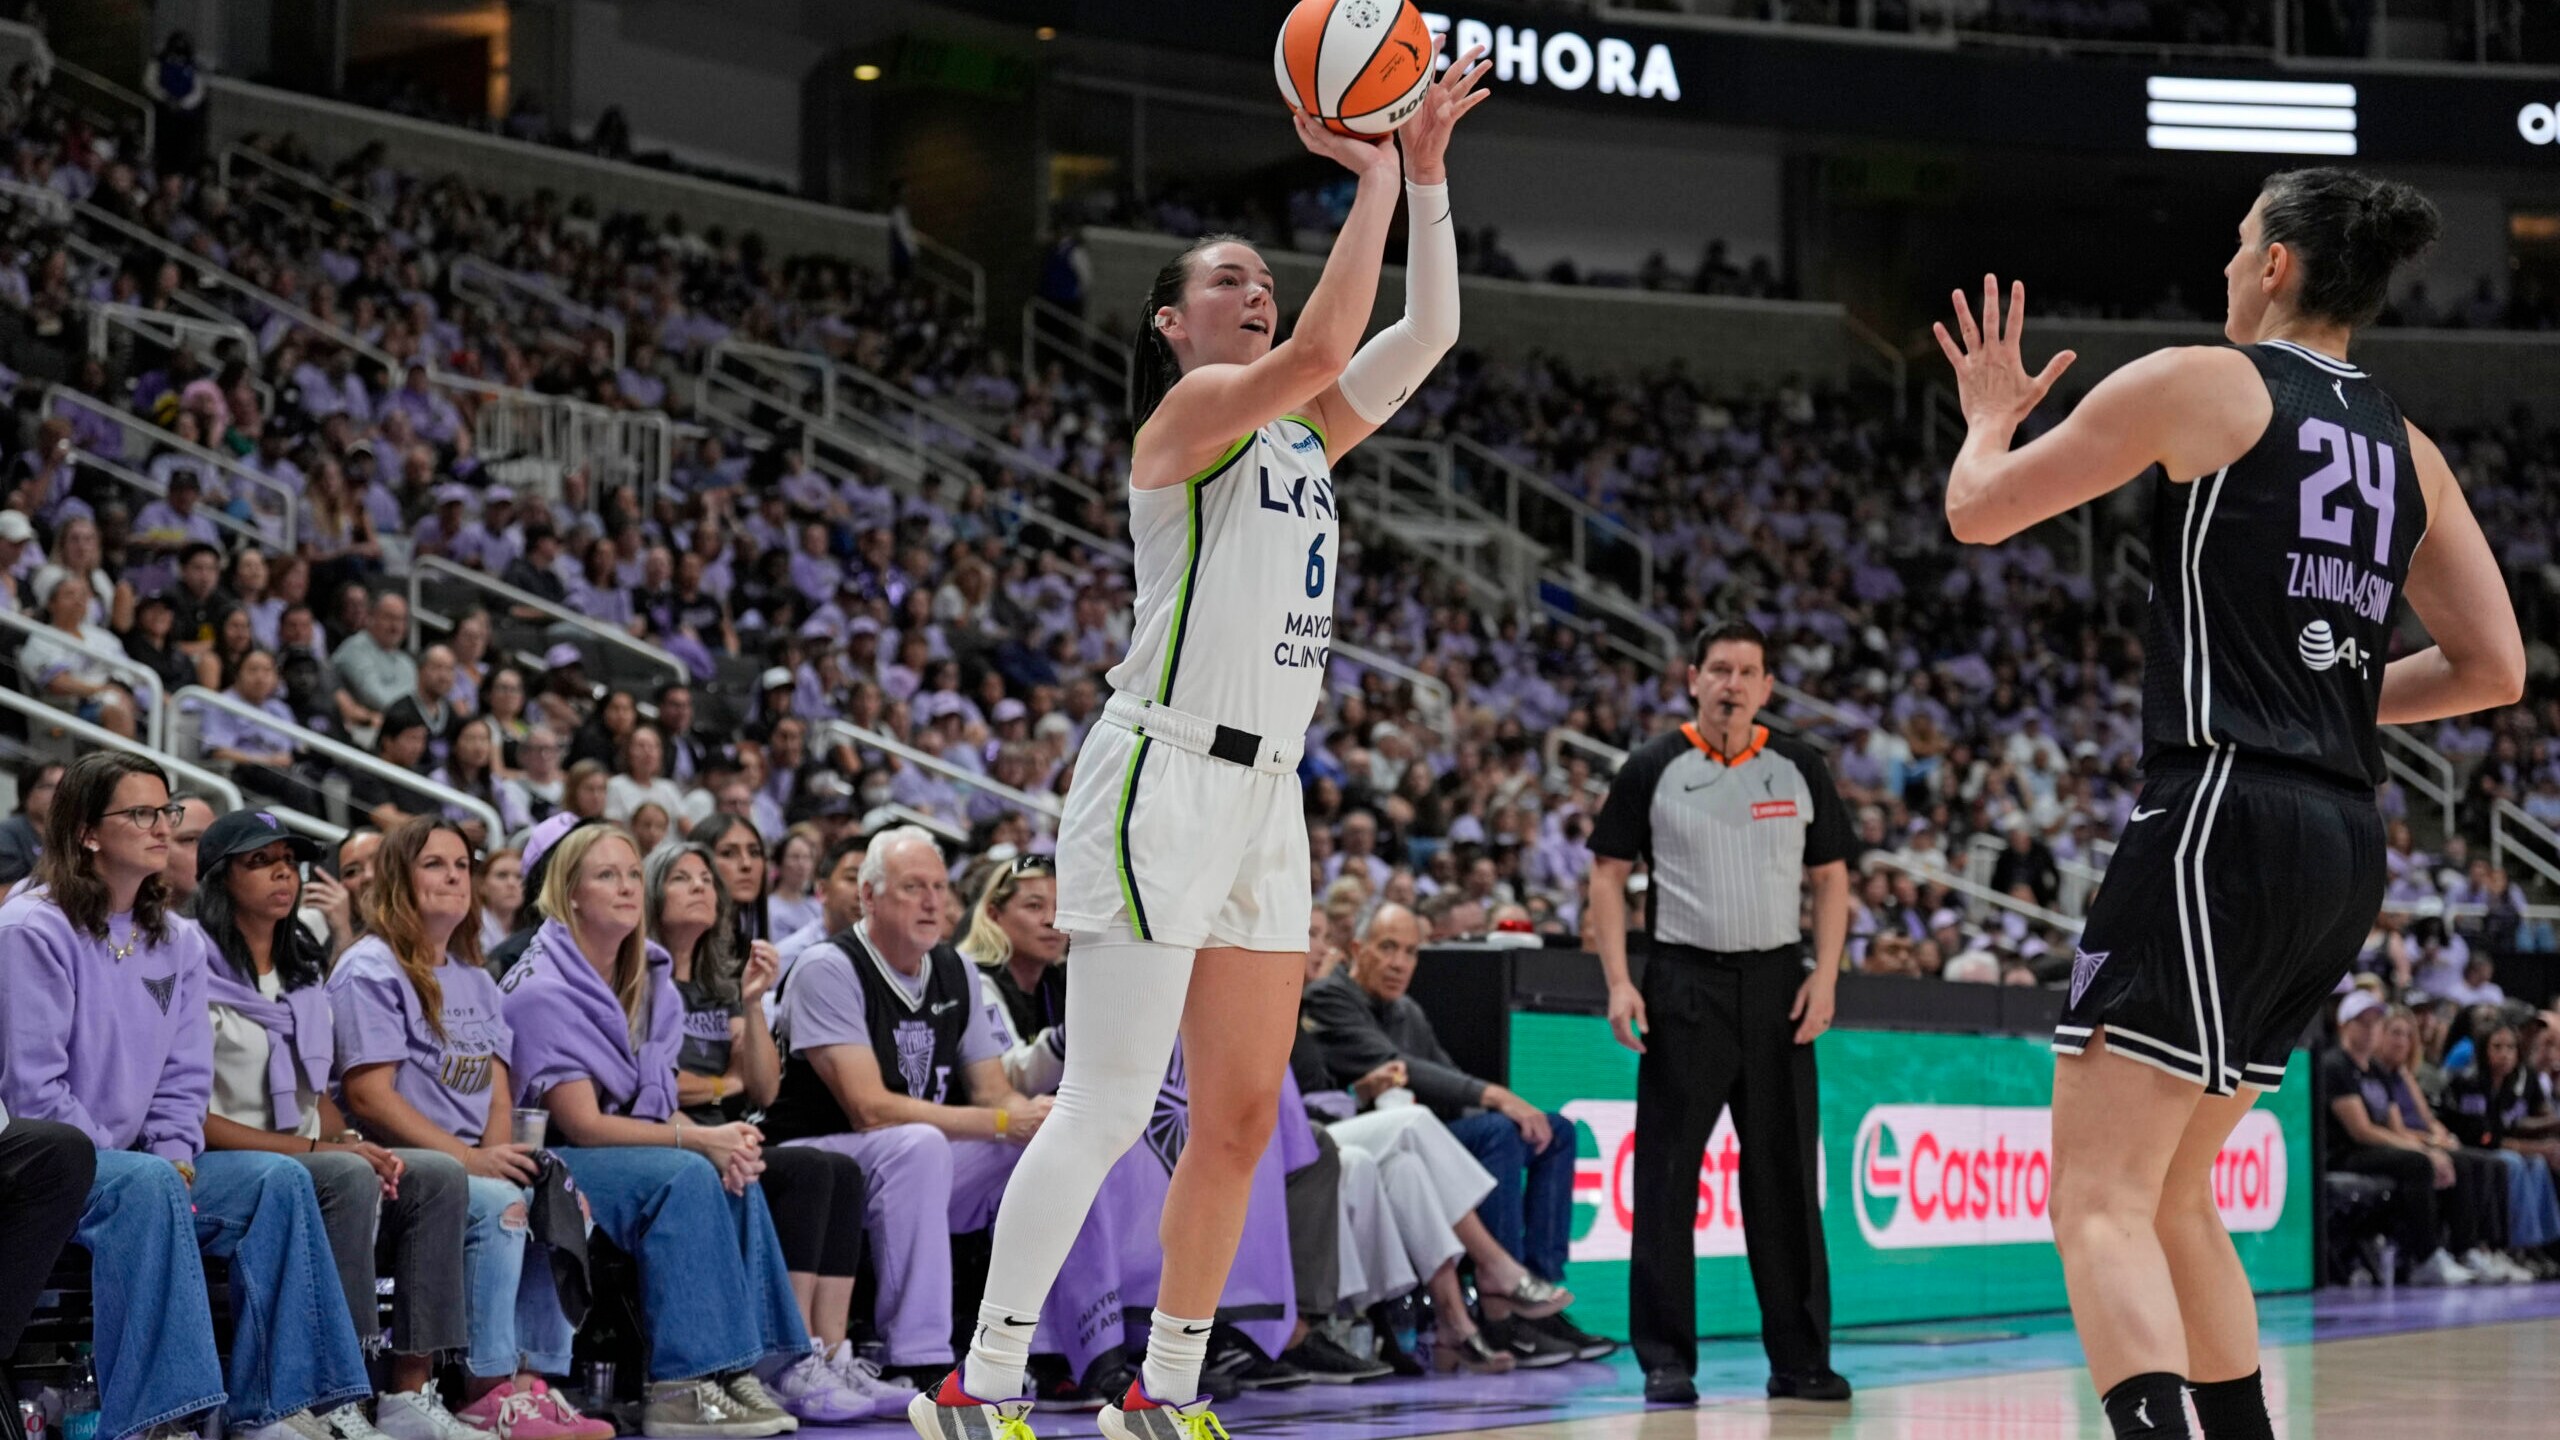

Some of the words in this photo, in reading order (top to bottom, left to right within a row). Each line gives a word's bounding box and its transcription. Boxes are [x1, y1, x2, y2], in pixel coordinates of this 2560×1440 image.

[1422, 12, 1681, 101] EPHORA
[2299, 417, 2396, 566] 24
[1306, 533, 1326, 598] 6
[1285, 612, 1331, 638] MAYO
[934, 1066, 951, 1105] 5
[1909, 1131, 2051, 1223] Castro
